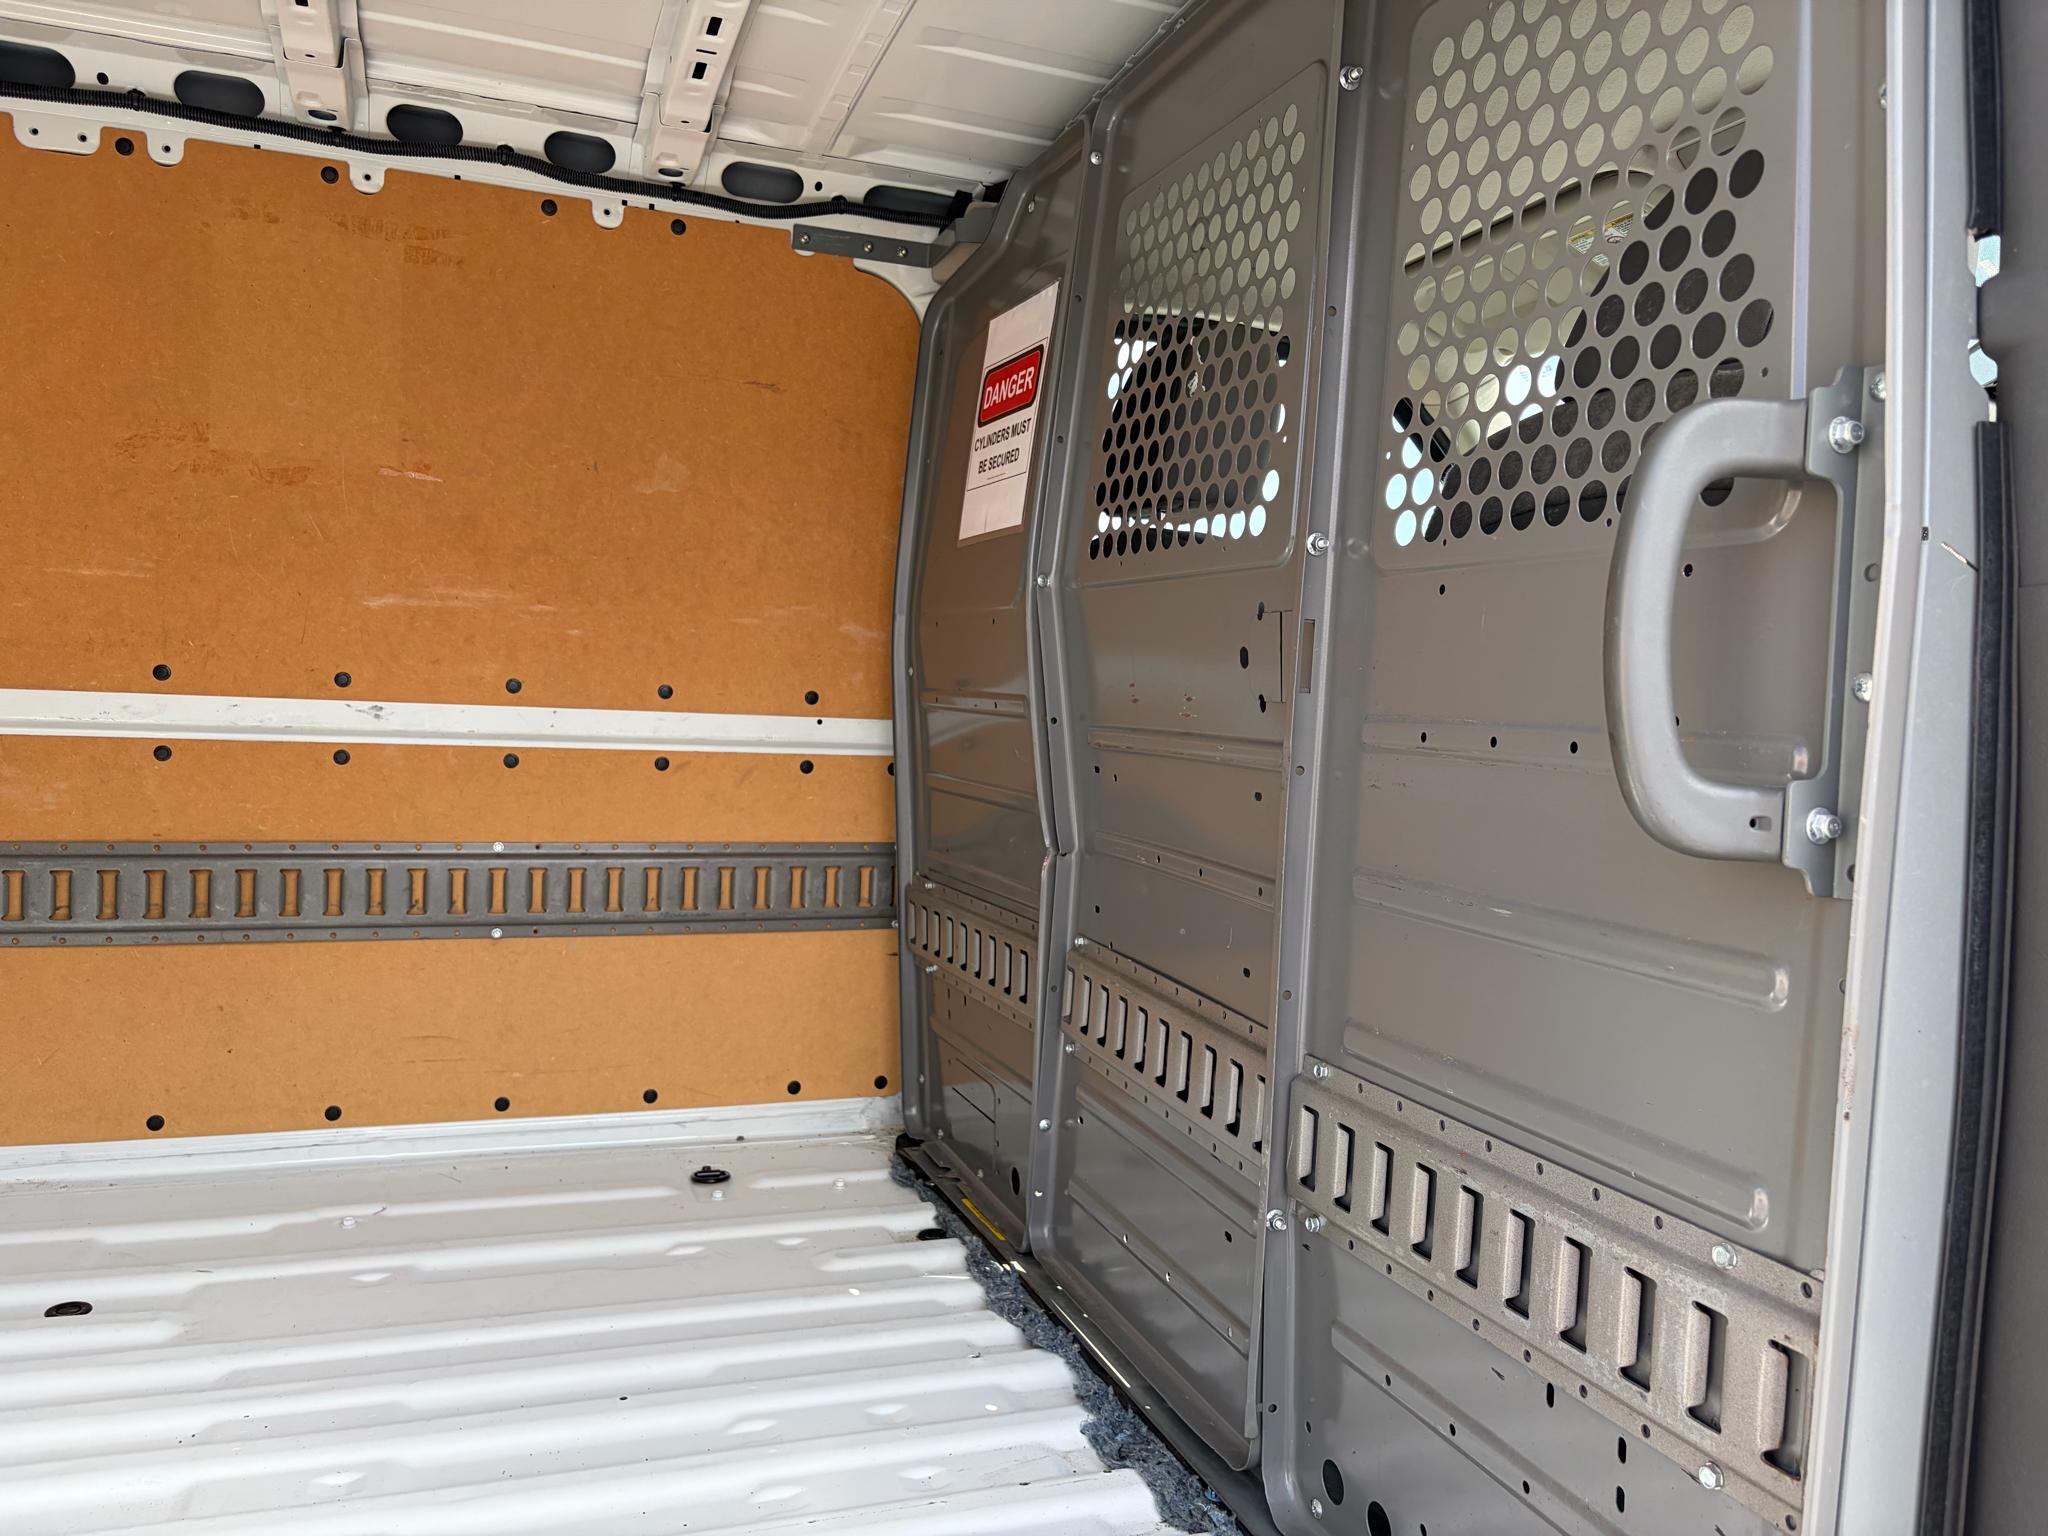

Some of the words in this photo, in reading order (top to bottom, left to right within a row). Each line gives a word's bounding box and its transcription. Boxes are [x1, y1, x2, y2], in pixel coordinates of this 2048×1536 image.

[983, 366, 1035, 410] DANGER
[974, 426, 1010, 452] CYLINDERS
[1010, 418, 1032, 438] MUST
[978, 459, 988, 474] BE
[988, 447, 1020, 471] SECURED
